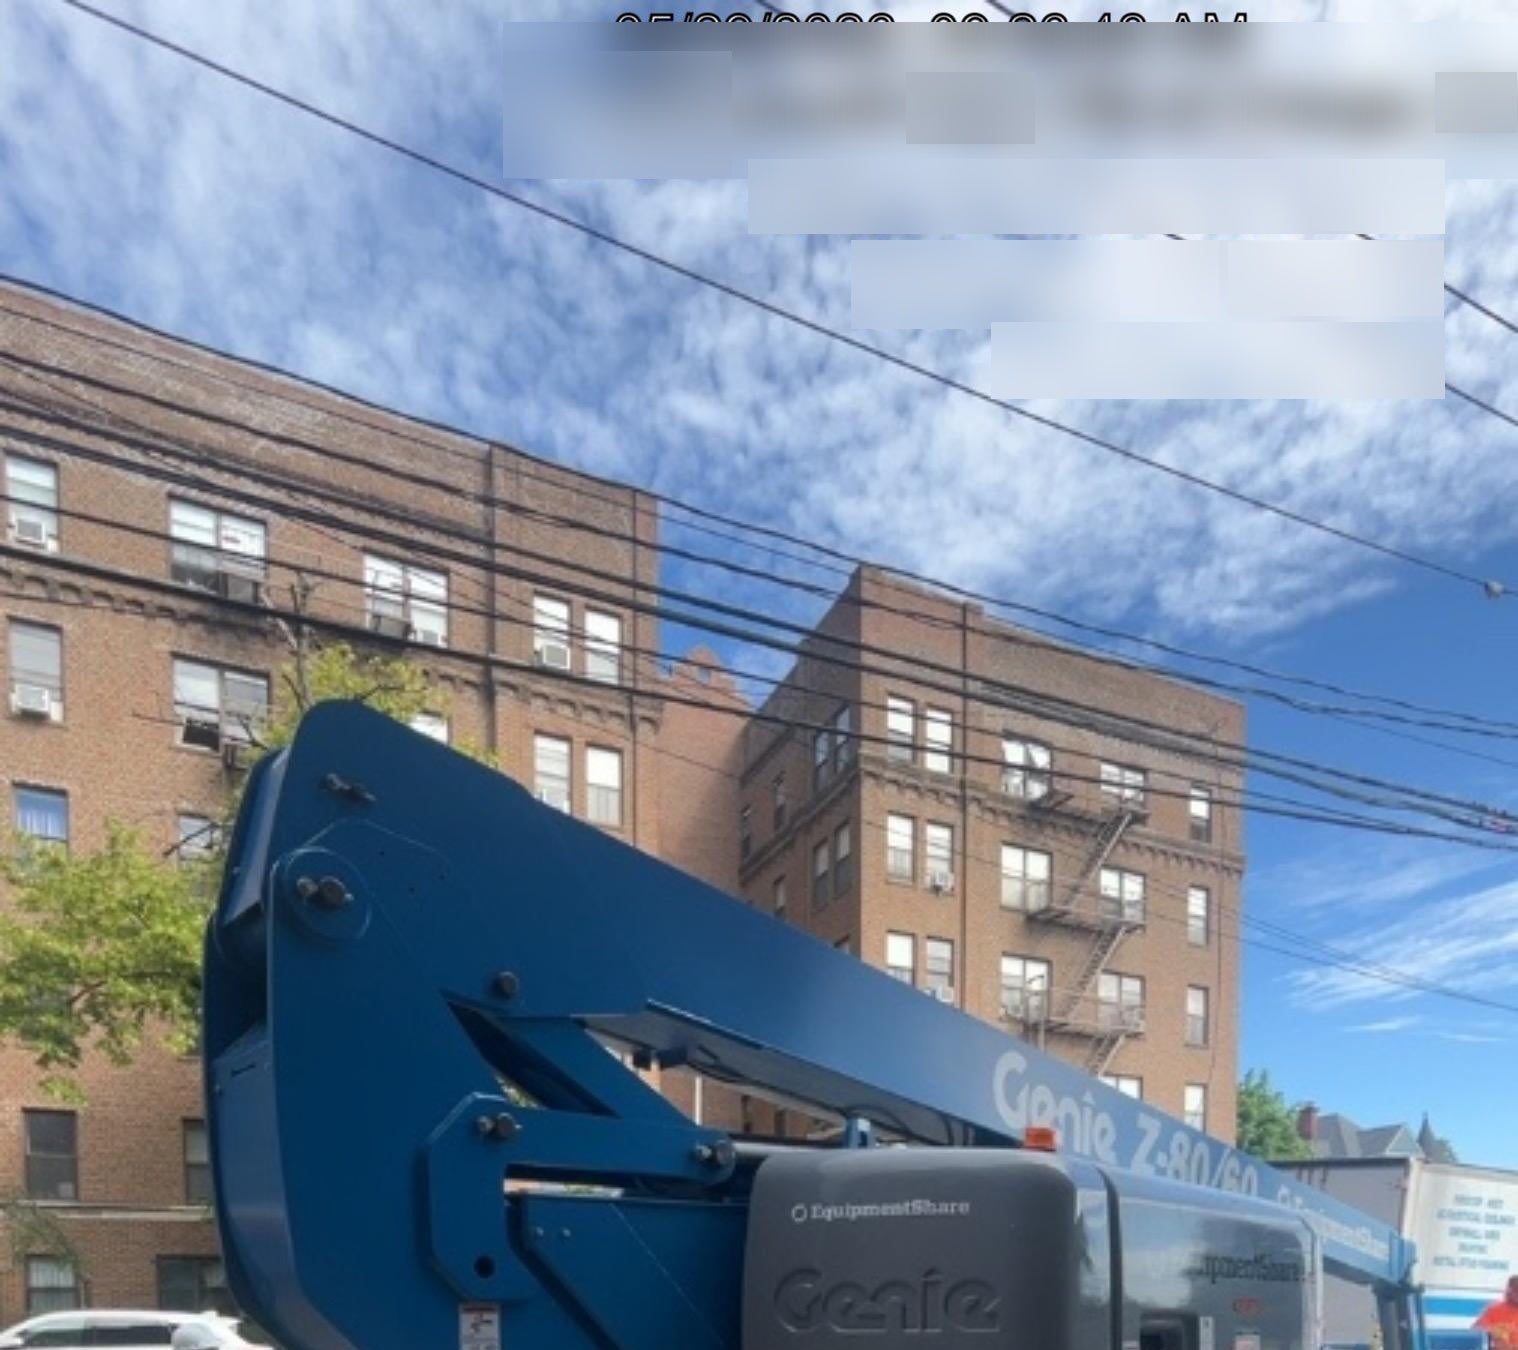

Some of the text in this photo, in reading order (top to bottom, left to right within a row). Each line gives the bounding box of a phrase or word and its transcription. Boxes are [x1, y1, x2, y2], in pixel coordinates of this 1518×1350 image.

[993, 1051, 1259, 1199] Genie Z-80/60
[811, 1199, 970, 1221] EquipmentShare
[773, 1266, 1001, 1334] Genie
